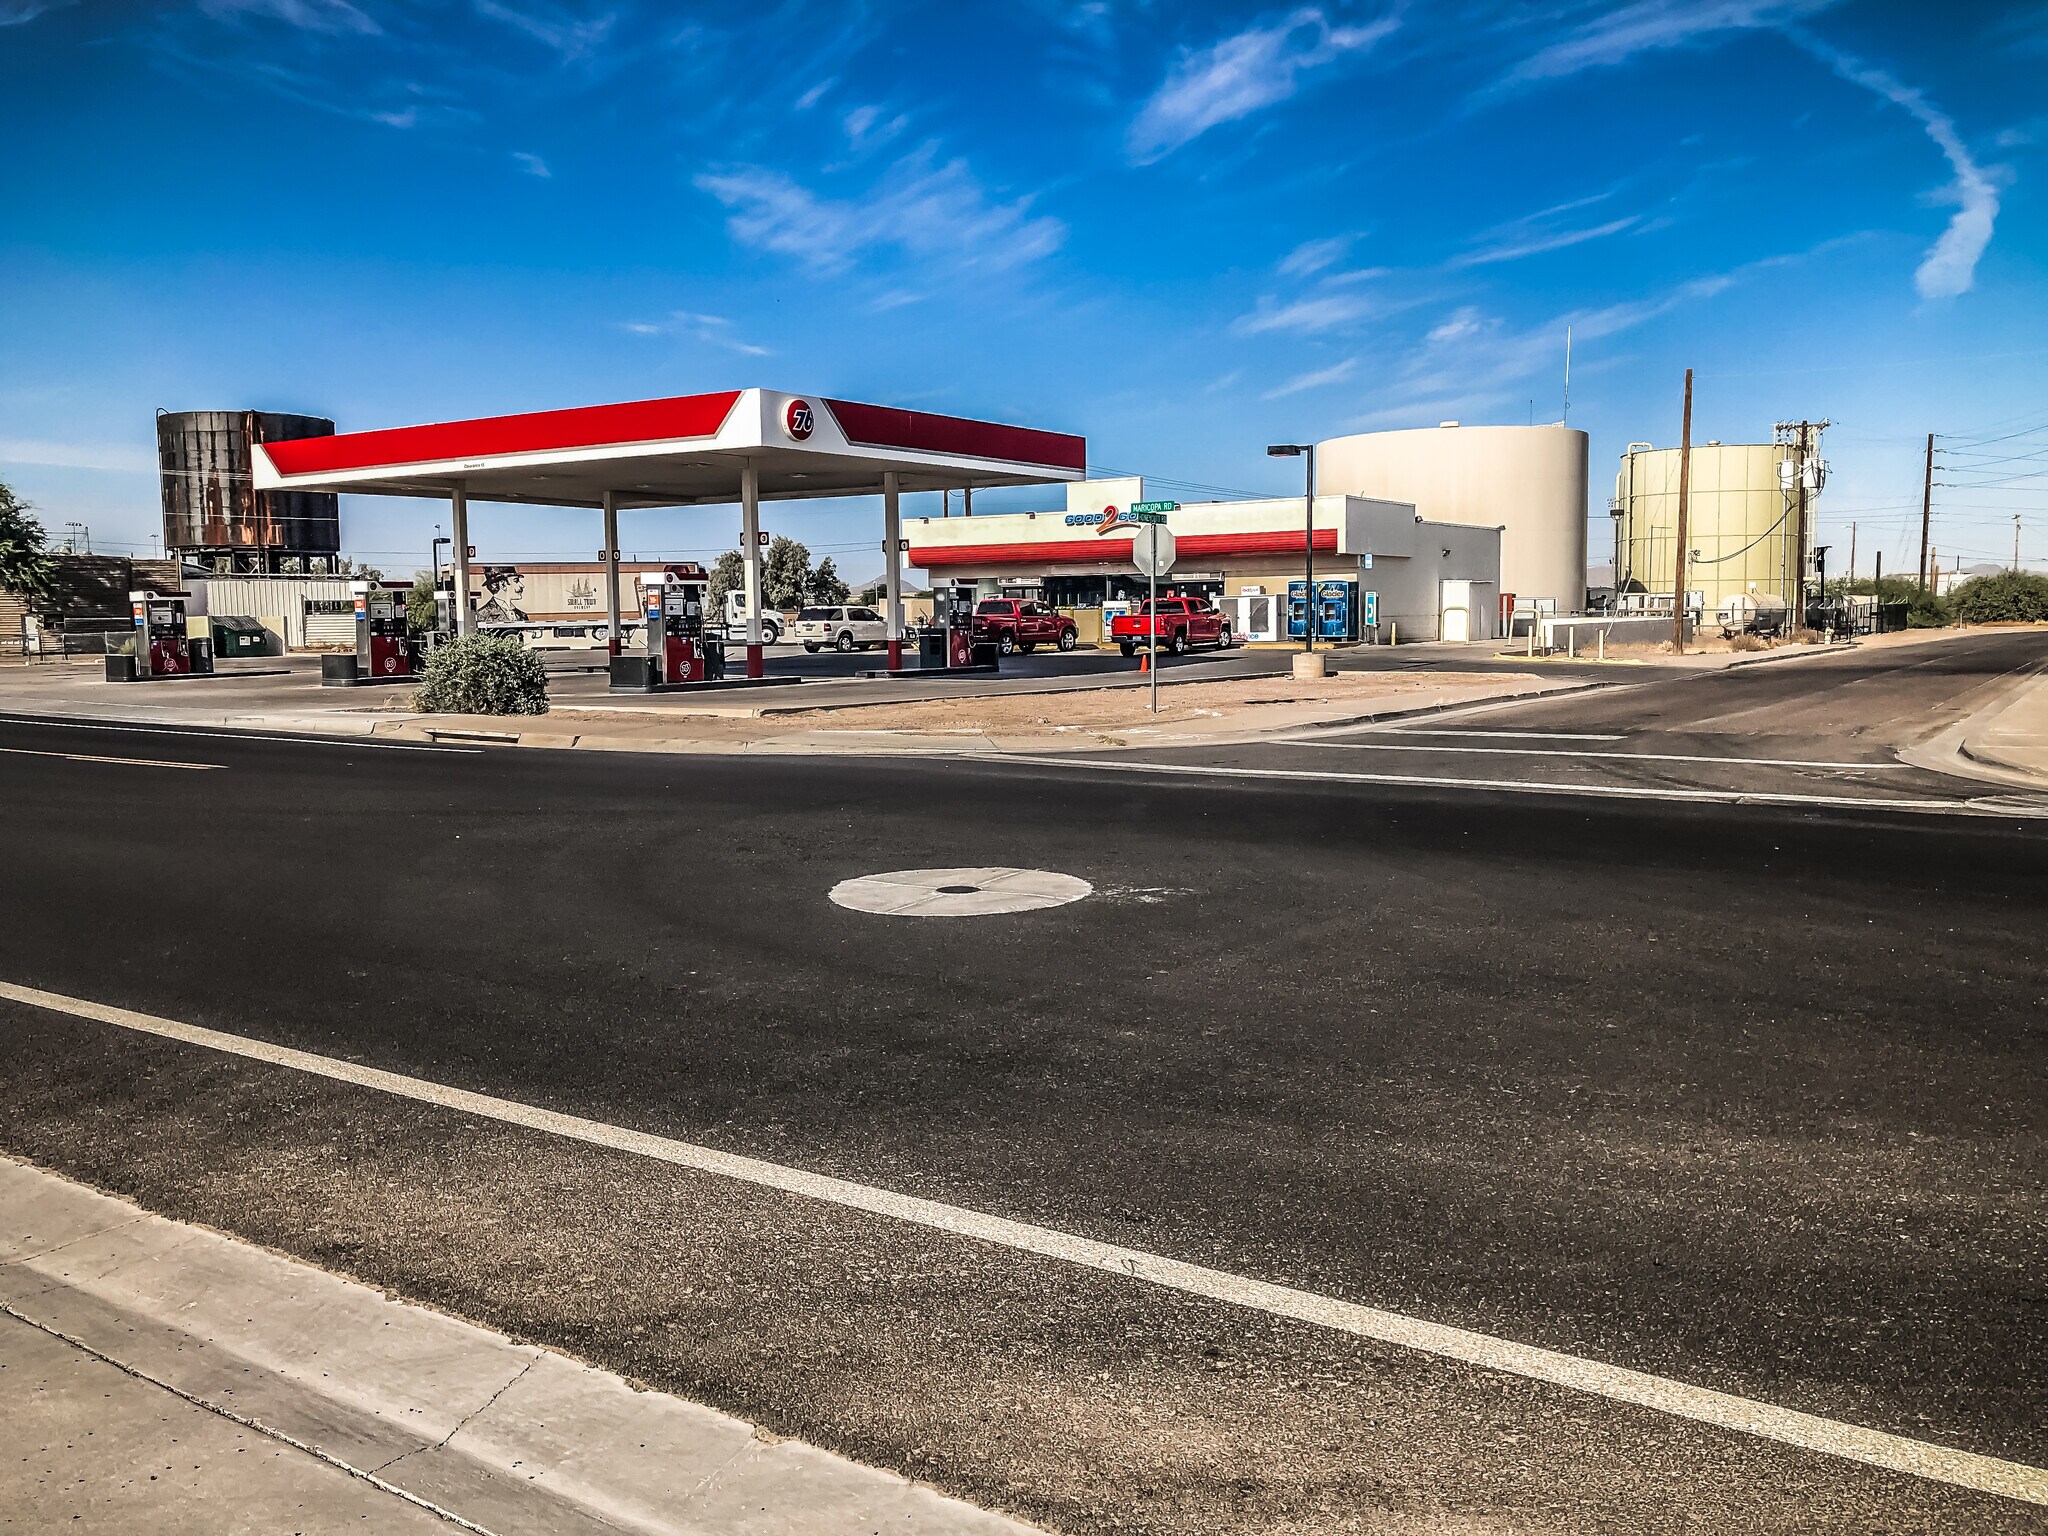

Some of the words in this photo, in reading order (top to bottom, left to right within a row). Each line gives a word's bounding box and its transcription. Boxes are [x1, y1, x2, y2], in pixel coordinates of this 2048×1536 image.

[792, 408, 813, 432] 76
[1132, 503, 1162, 512] MARICOPA
[1163, 502, 1172, 510] RD
[1321, 590, 1344, 598] Glacier
